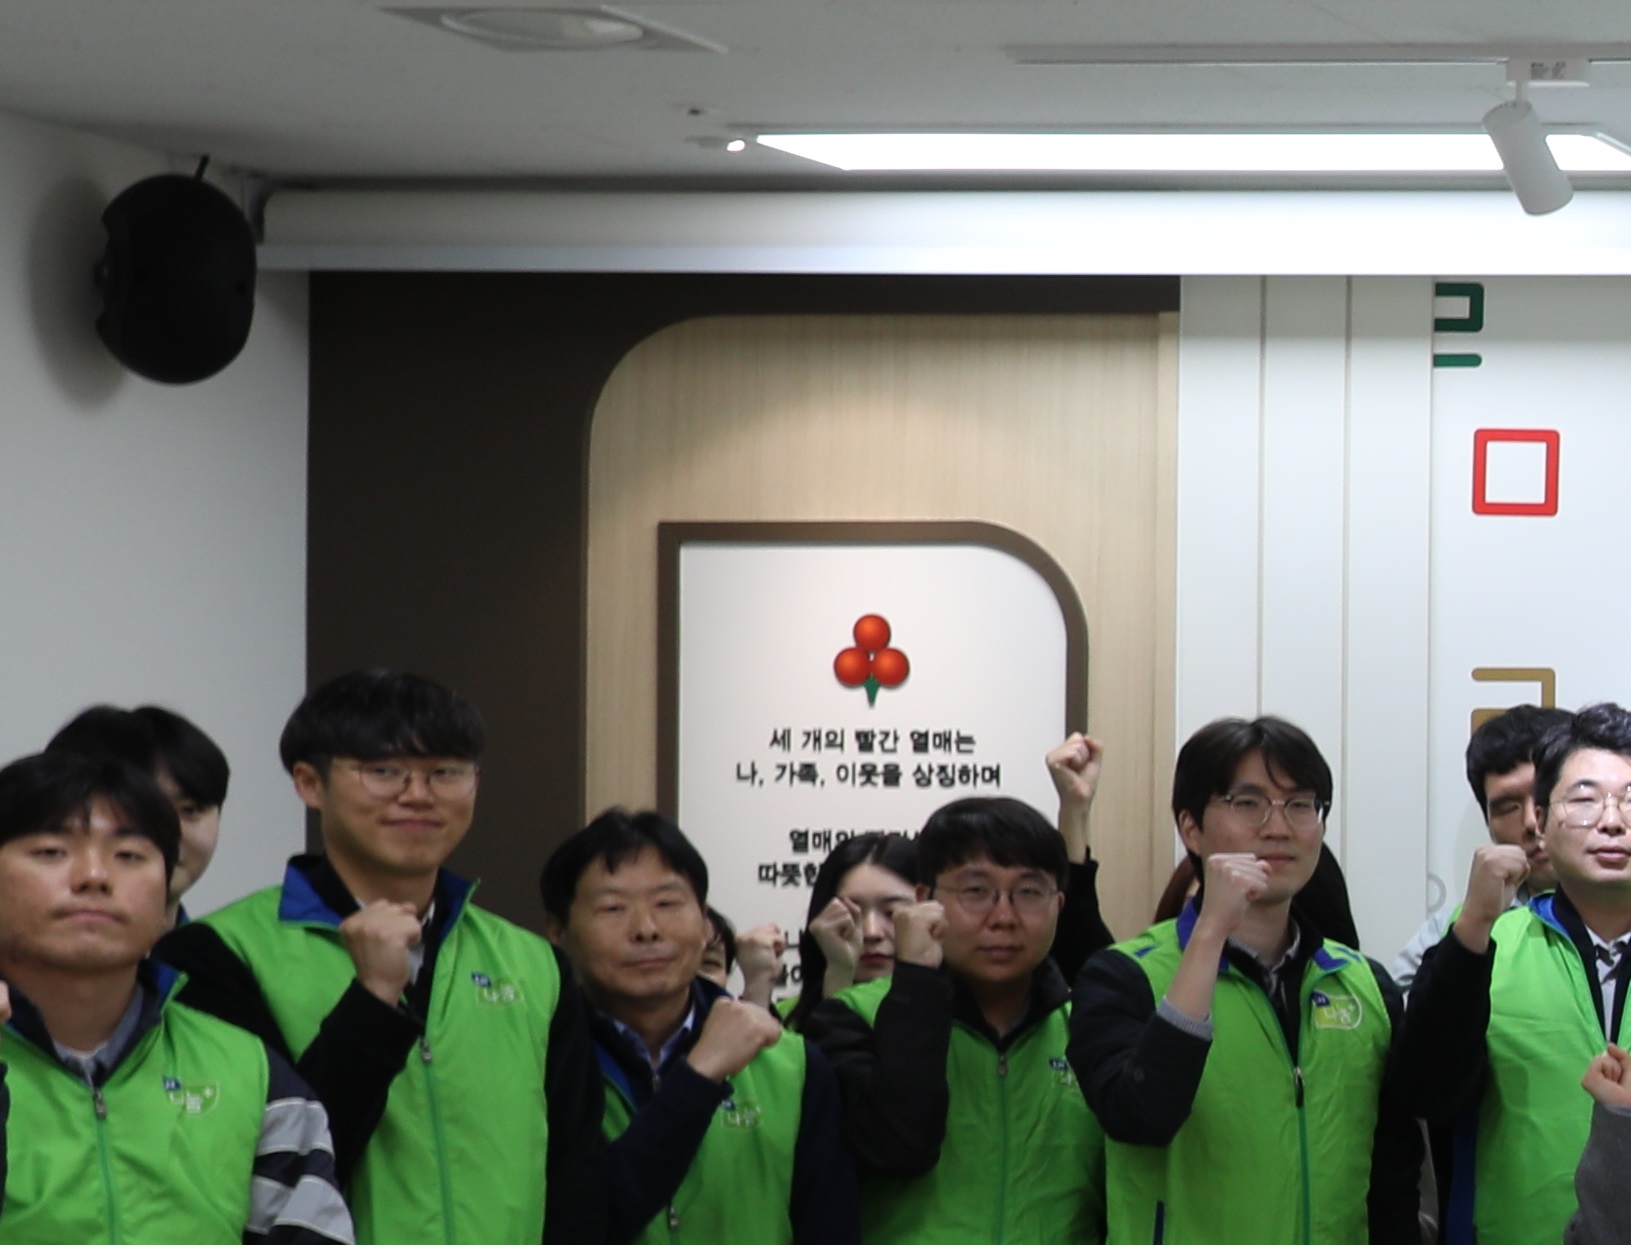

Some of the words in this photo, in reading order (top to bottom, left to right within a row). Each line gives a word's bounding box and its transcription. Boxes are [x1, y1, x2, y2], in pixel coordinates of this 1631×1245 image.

[770, 728, 791, 752] 세
[801, 728, 845, 752] 개의
[855, 728, 899, 753] 빨간
[910, 728, 976, 753] 열매는
[736, 762, 764, 788] 나,
[774, 762, 825, 788] 가족,
[836, 762, 901, 788] 이웃을
[912, 763, 1001, 788] 상징하며
